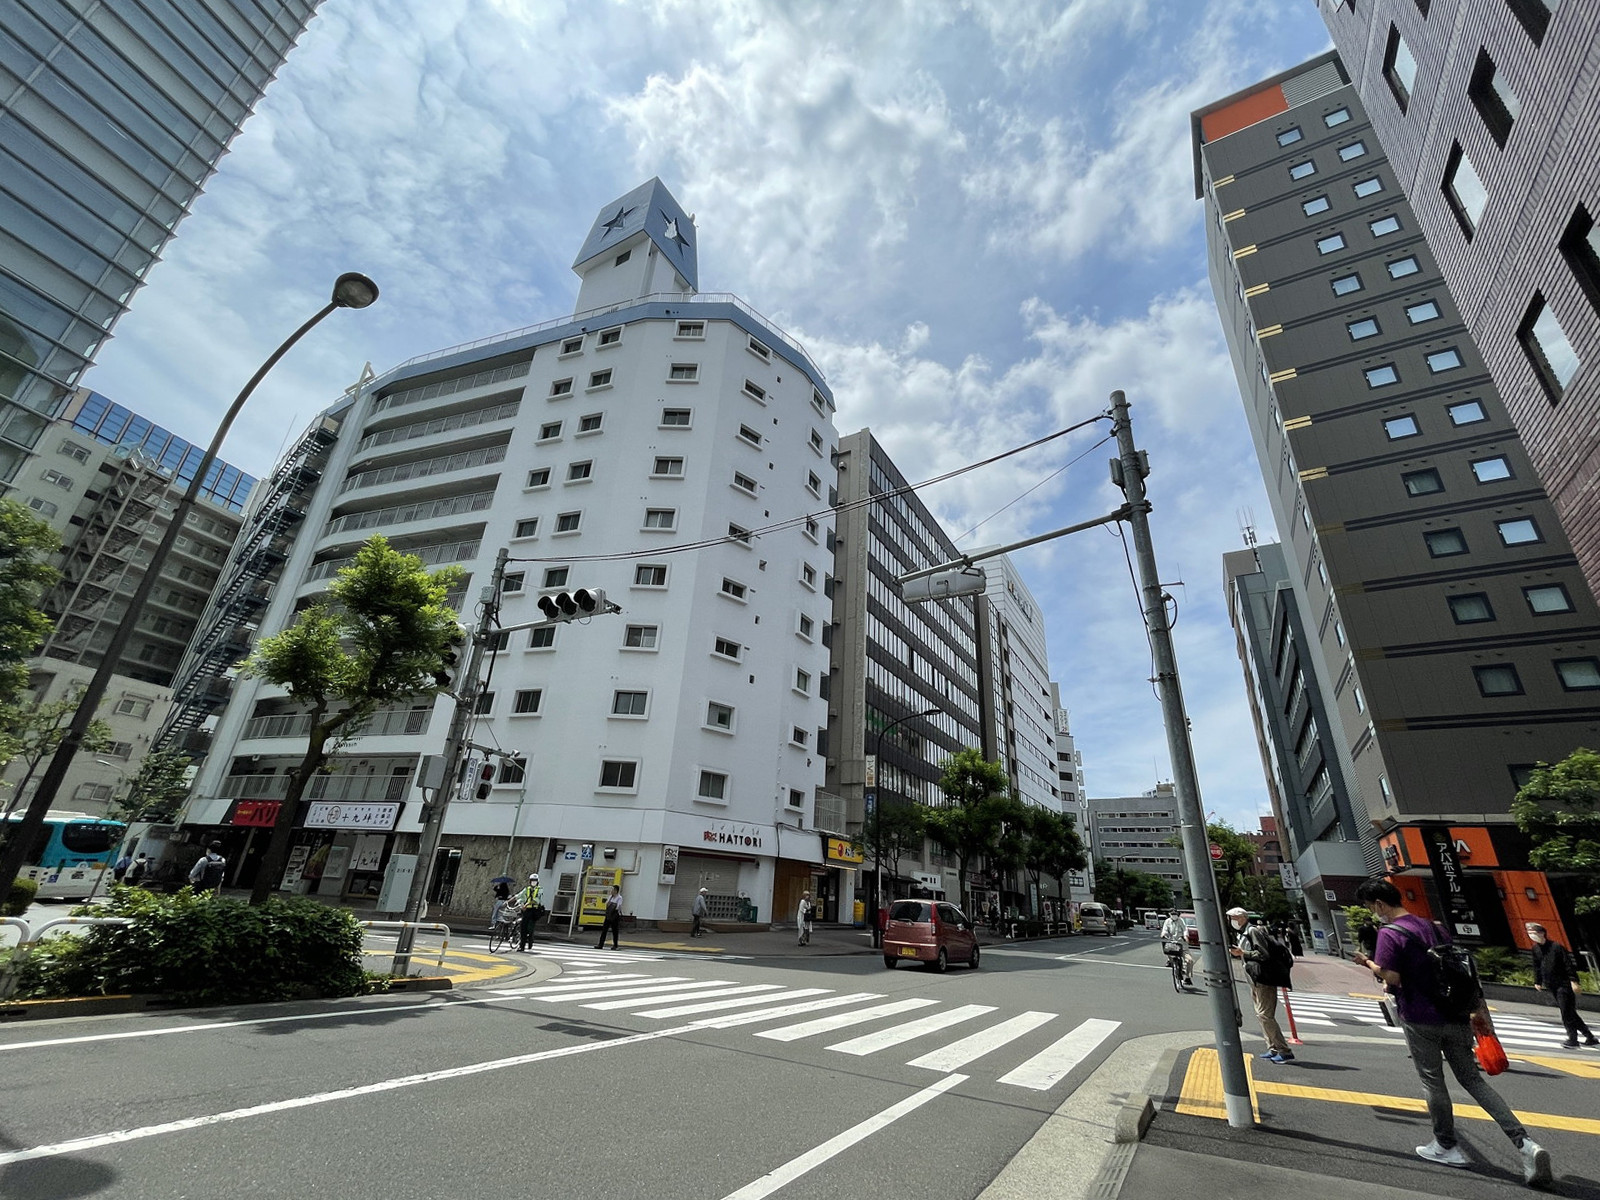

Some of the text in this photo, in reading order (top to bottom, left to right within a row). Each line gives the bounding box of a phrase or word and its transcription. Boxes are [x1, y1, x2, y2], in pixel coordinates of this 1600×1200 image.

[719, 832, 762, 848] HATTORI
[1436, 842, 1461, 893] アパホテル
